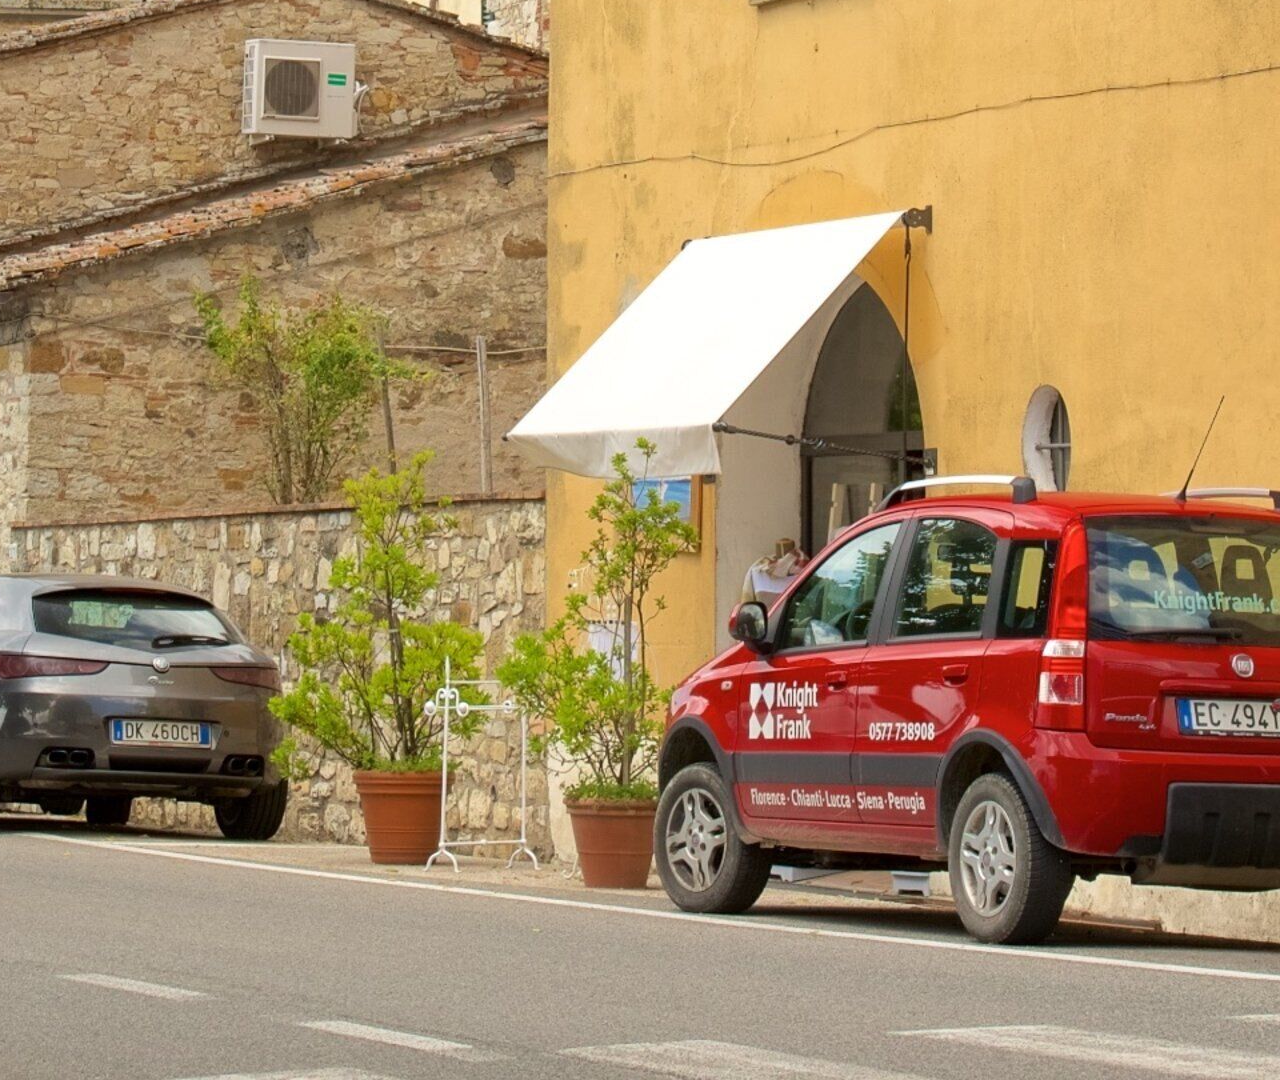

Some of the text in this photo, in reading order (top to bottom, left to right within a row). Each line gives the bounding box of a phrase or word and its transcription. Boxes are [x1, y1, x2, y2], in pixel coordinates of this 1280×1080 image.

[777, 682, 818, 713] Knight
[776, 714, 811, 739] Frank
[1194, 703, 1220, 727] EC
[125, 723, 143, 739] DK
[152, 723, 199, 741] 460CH
[869, 723, 935, 741] 0577 738908
[750, 788, 925, 814] Florence Chianti Lucca Siena Perugia
